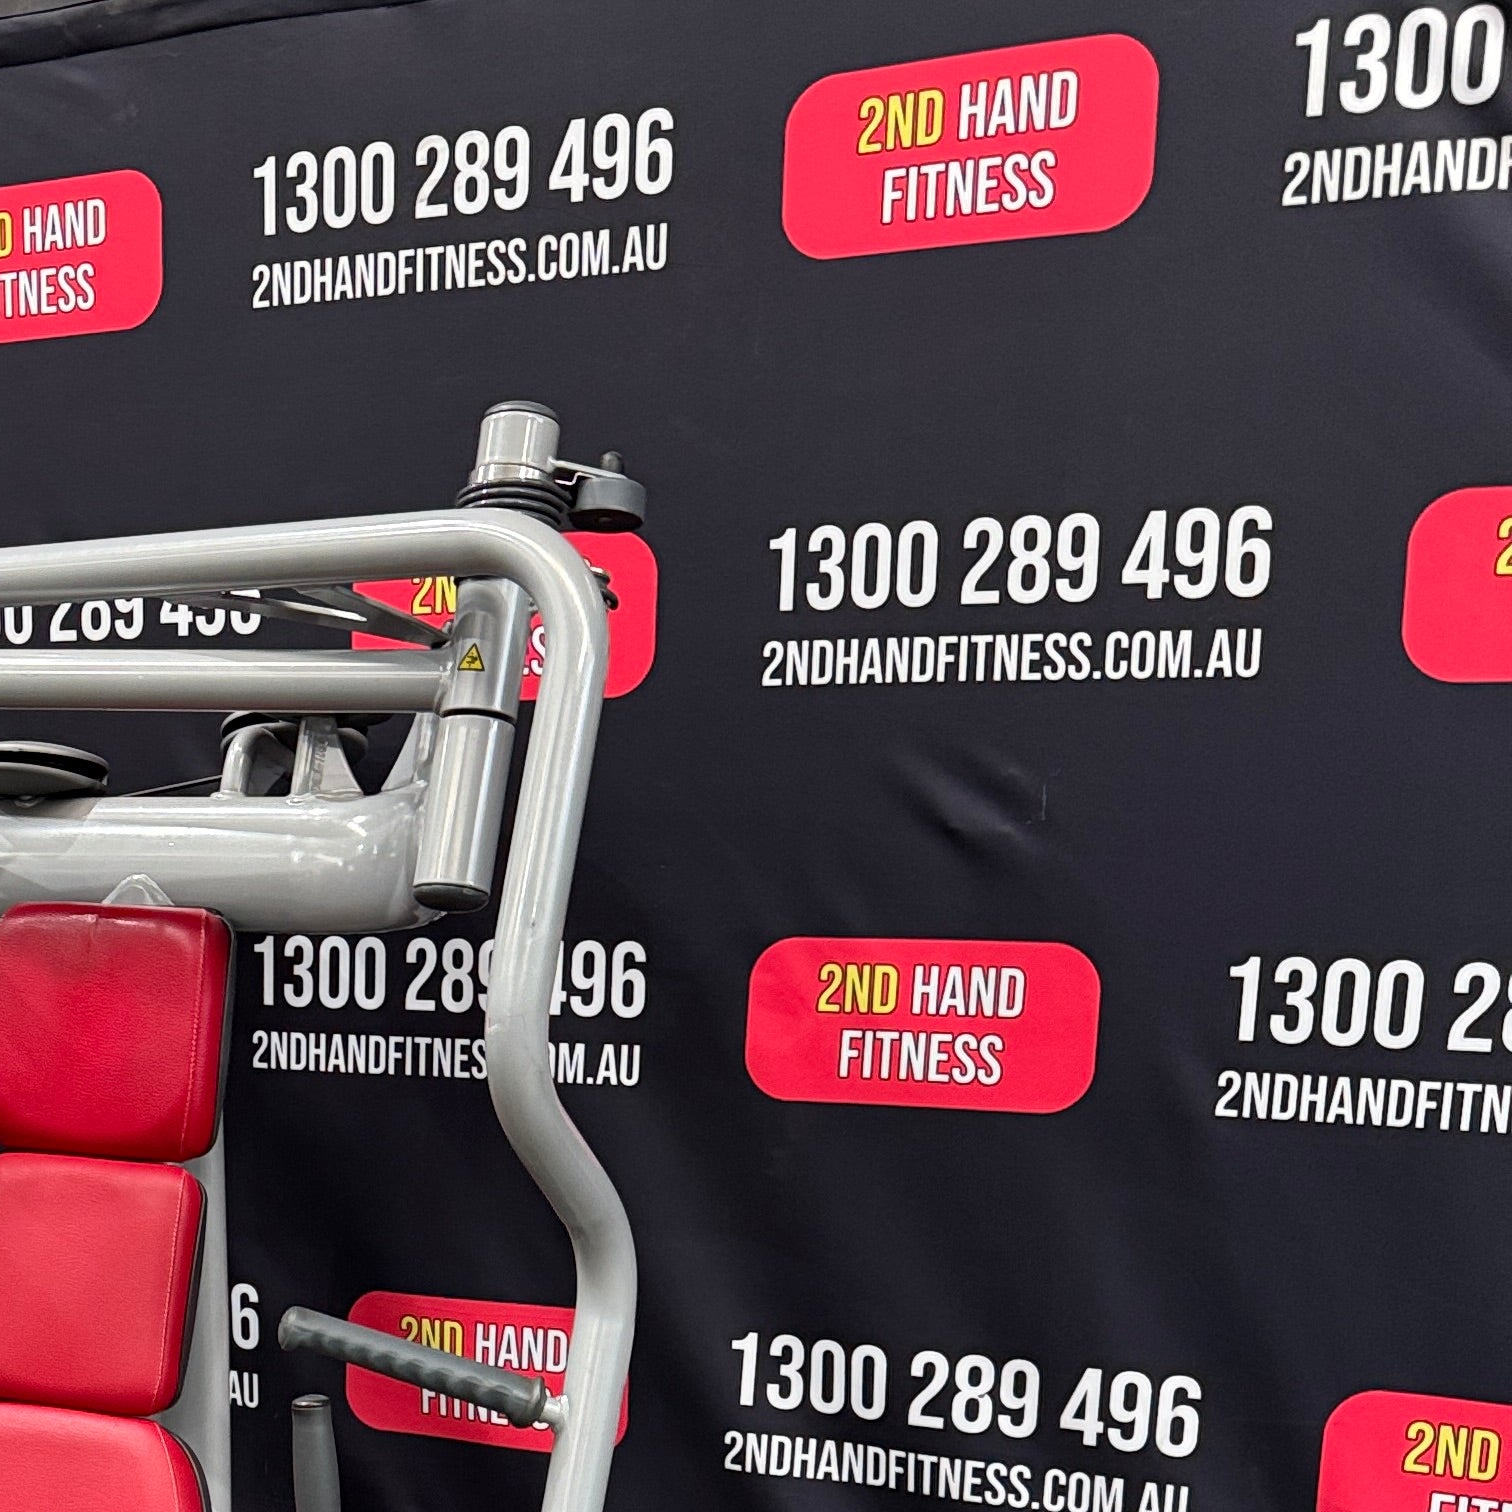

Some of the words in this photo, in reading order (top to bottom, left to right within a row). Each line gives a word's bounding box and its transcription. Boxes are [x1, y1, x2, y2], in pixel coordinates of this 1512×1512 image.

[1295, 3, 1508, 118] 1300
[856, 88, 945, 155] 2ND
[957, 69, 1079, 141] HAND
[252, 141, 395, 237] 1300
[413, 125, 531, 220] 289
[548, 108, 675, 204] 496
[880, 149, 1057, 226] FITNESS
[21, 198, 107, 255] HAND
[251, 222, 668, 310] 2NDHANDFITNESS.COM.AU
[768, 520, 939, 613] 1300
[960, 512, 1101, 606] 289
[1121, 504, 1274, 601] 496
[761, 628, 1262, 688] 2NDHANDFITNESS.COM.AU
[253, 935, 387, 1010] 1300
[817, 961, 899, 1016] 2ND
[910, 964, 1027, 1021] HAND
[1227, 954, 1425, 1052] 1300
[837, 1027, 1005, 1087] FITNESS
[475, 1321, 568, 1374] HAND
[730, 1330, 888, 1421] 1300
[907, 1350, 1041, 1440] 289
[1060, 1366, 1203, 1459] 496
[1403, 1421, 1500, 1483] 2ND
